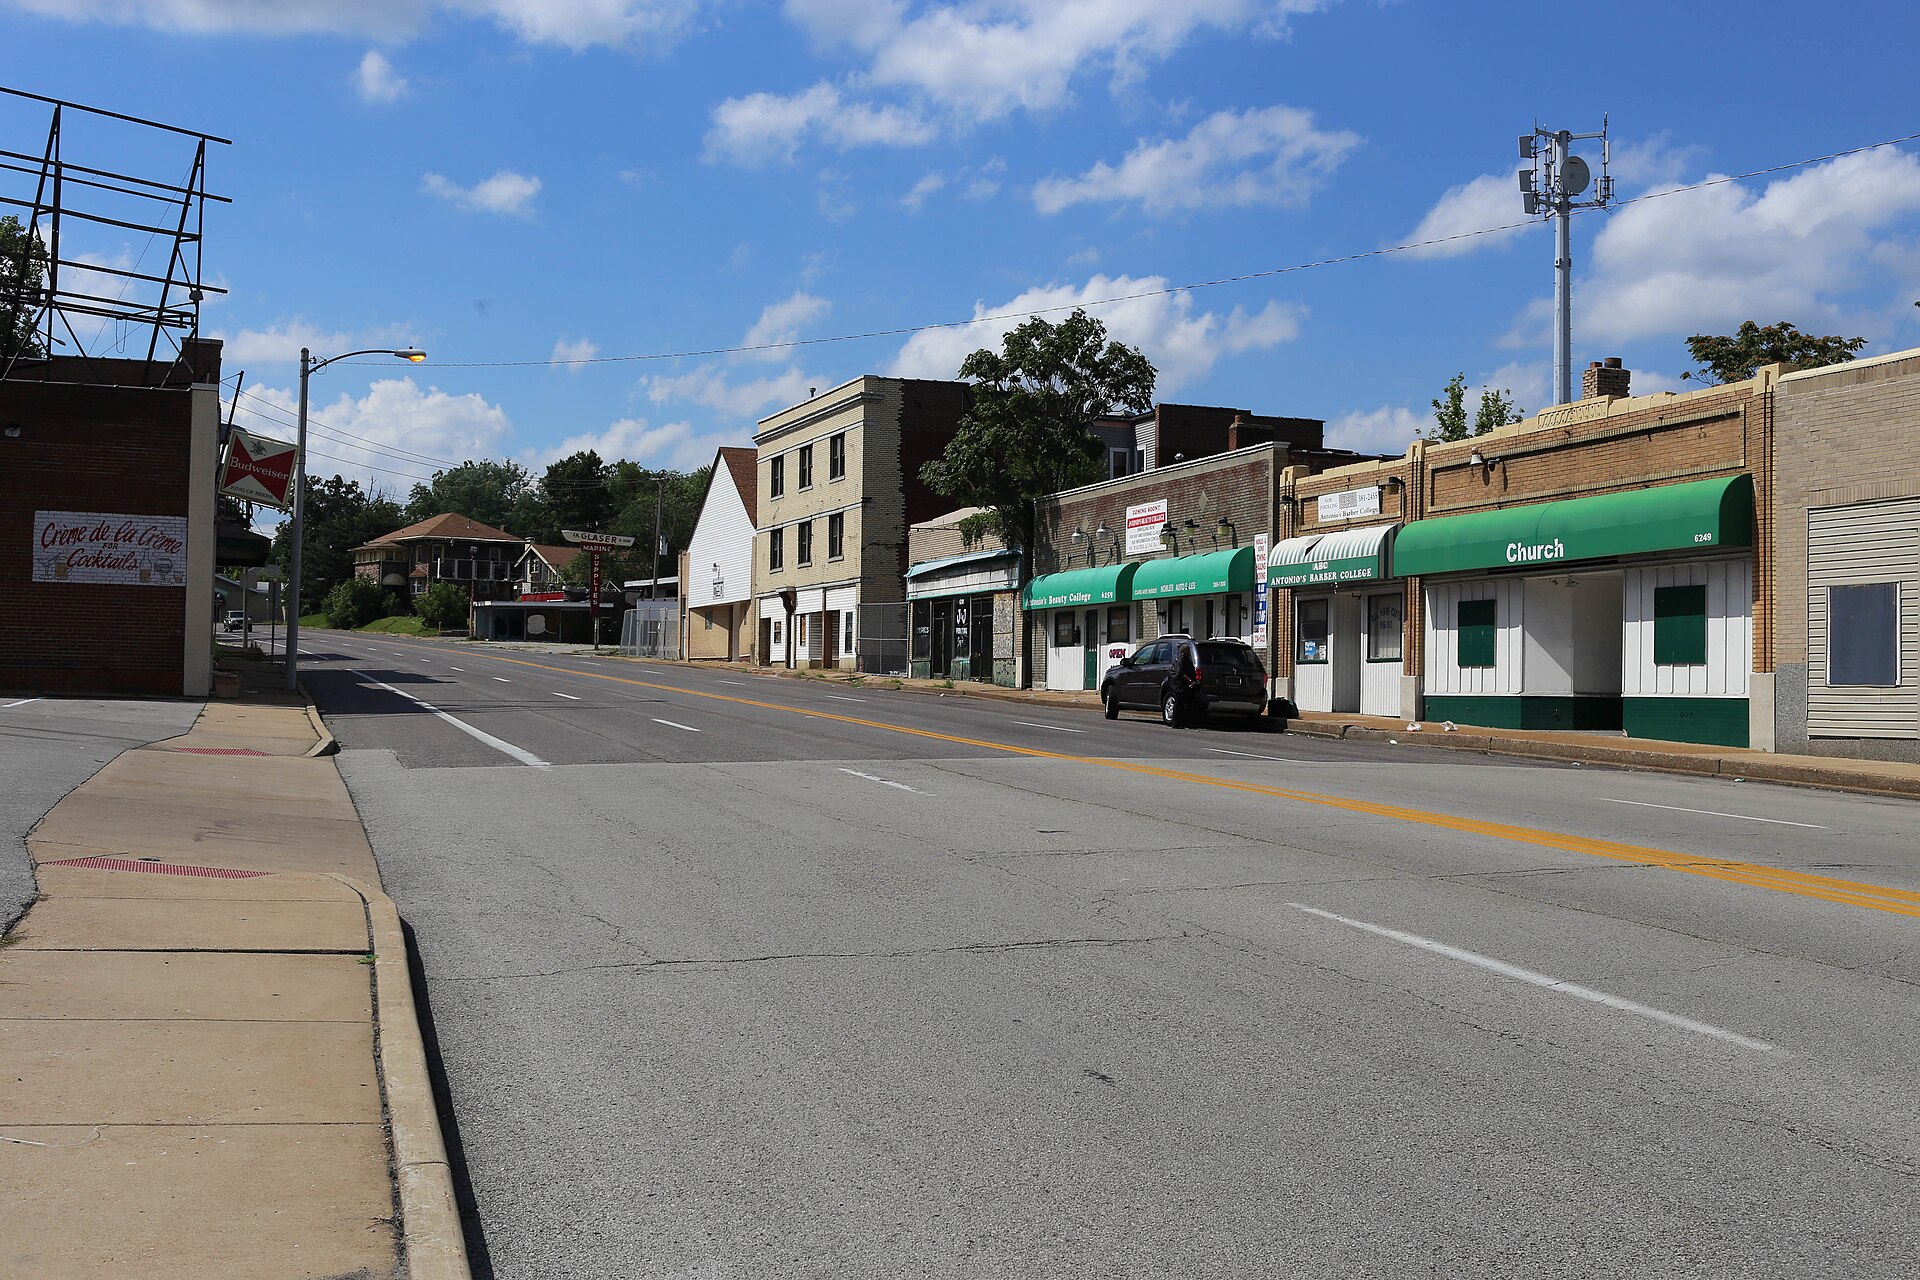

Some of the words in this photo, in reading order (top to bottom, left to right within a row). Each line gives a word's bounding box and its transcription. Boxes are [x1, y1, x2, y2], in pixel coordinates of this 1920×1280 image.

[230, 456, 289, 480] Budweiser
[231, 485, 246, 493] KING
[1321, 511, 1342, 519] Antonio's
[1342, 509, 1359, 517] Barber
[1360, 507, 1379, 515] College
[89, 520, 110, 543] de
[115, 520, 138, 543] la
[1694, 532, 1712, 543] 6249
[581, 532, 617, 544] GLASER
[1506, 538, 1564, 562] Church
[66, 547, 139, 571] Cocktails
[1312, 561, 1328, 571] ABC
[1271, 574, 1307, 586] ANTONIO'S
[1309, 571, 1337, 583] BARBER
[1340, 568, 1372, 579] COLLEGE
[1048, 595, 1068, 605] Beauty
[1069, 592, 1091, 603] College
[1109, 648, 1127, 659] OPEN
